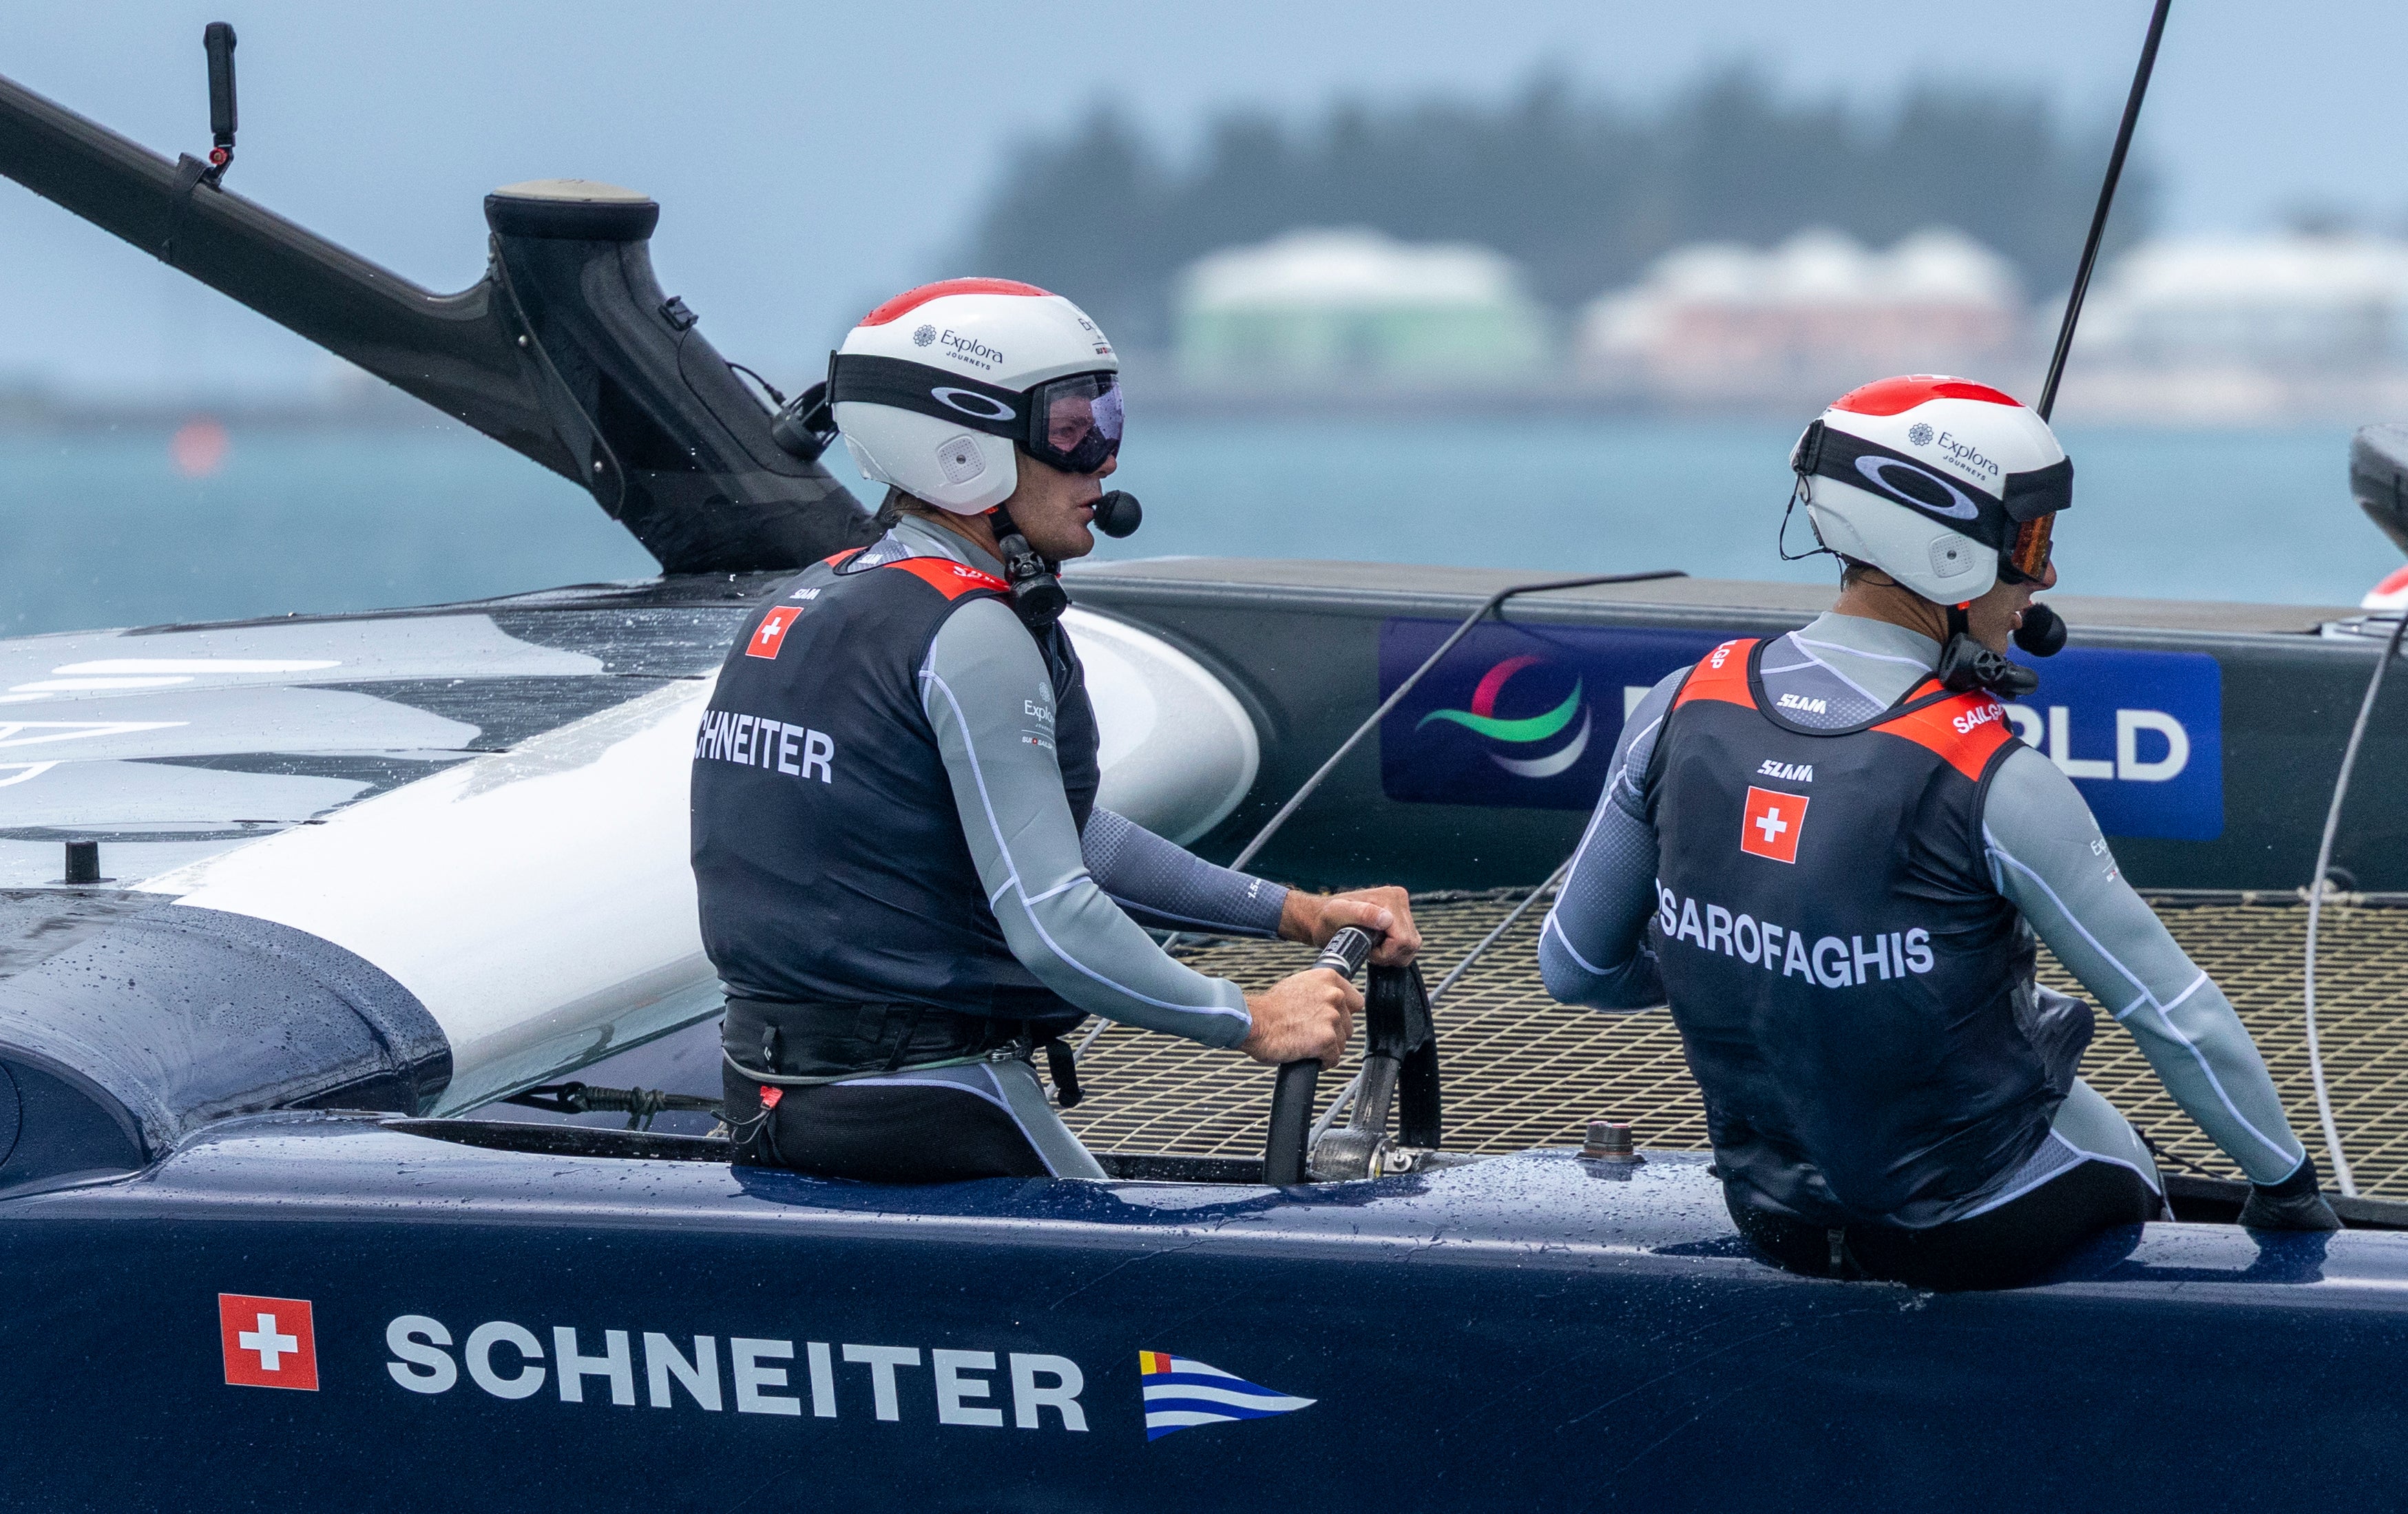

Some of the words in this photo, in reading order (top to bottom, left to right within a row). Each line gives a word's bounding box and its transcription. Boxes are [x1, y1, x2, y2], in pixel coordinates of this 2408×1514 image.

[941, 329, 1003, 364] Explora
[945, 351, 991, 370] JOURNEYS
[1938, 432, 1998, 476] Explora
[1943, 455, 1987, 481] JOURNEYS
[1024, 699, 1055, 724] Explo
[1776, 693, 1827, 715] SLAM
[695, 709, 835, 784] CHNEITER
[1757, 759, 1813, 782] SLAM
[386, 1315, 1089, 1433] SCHNEITER
